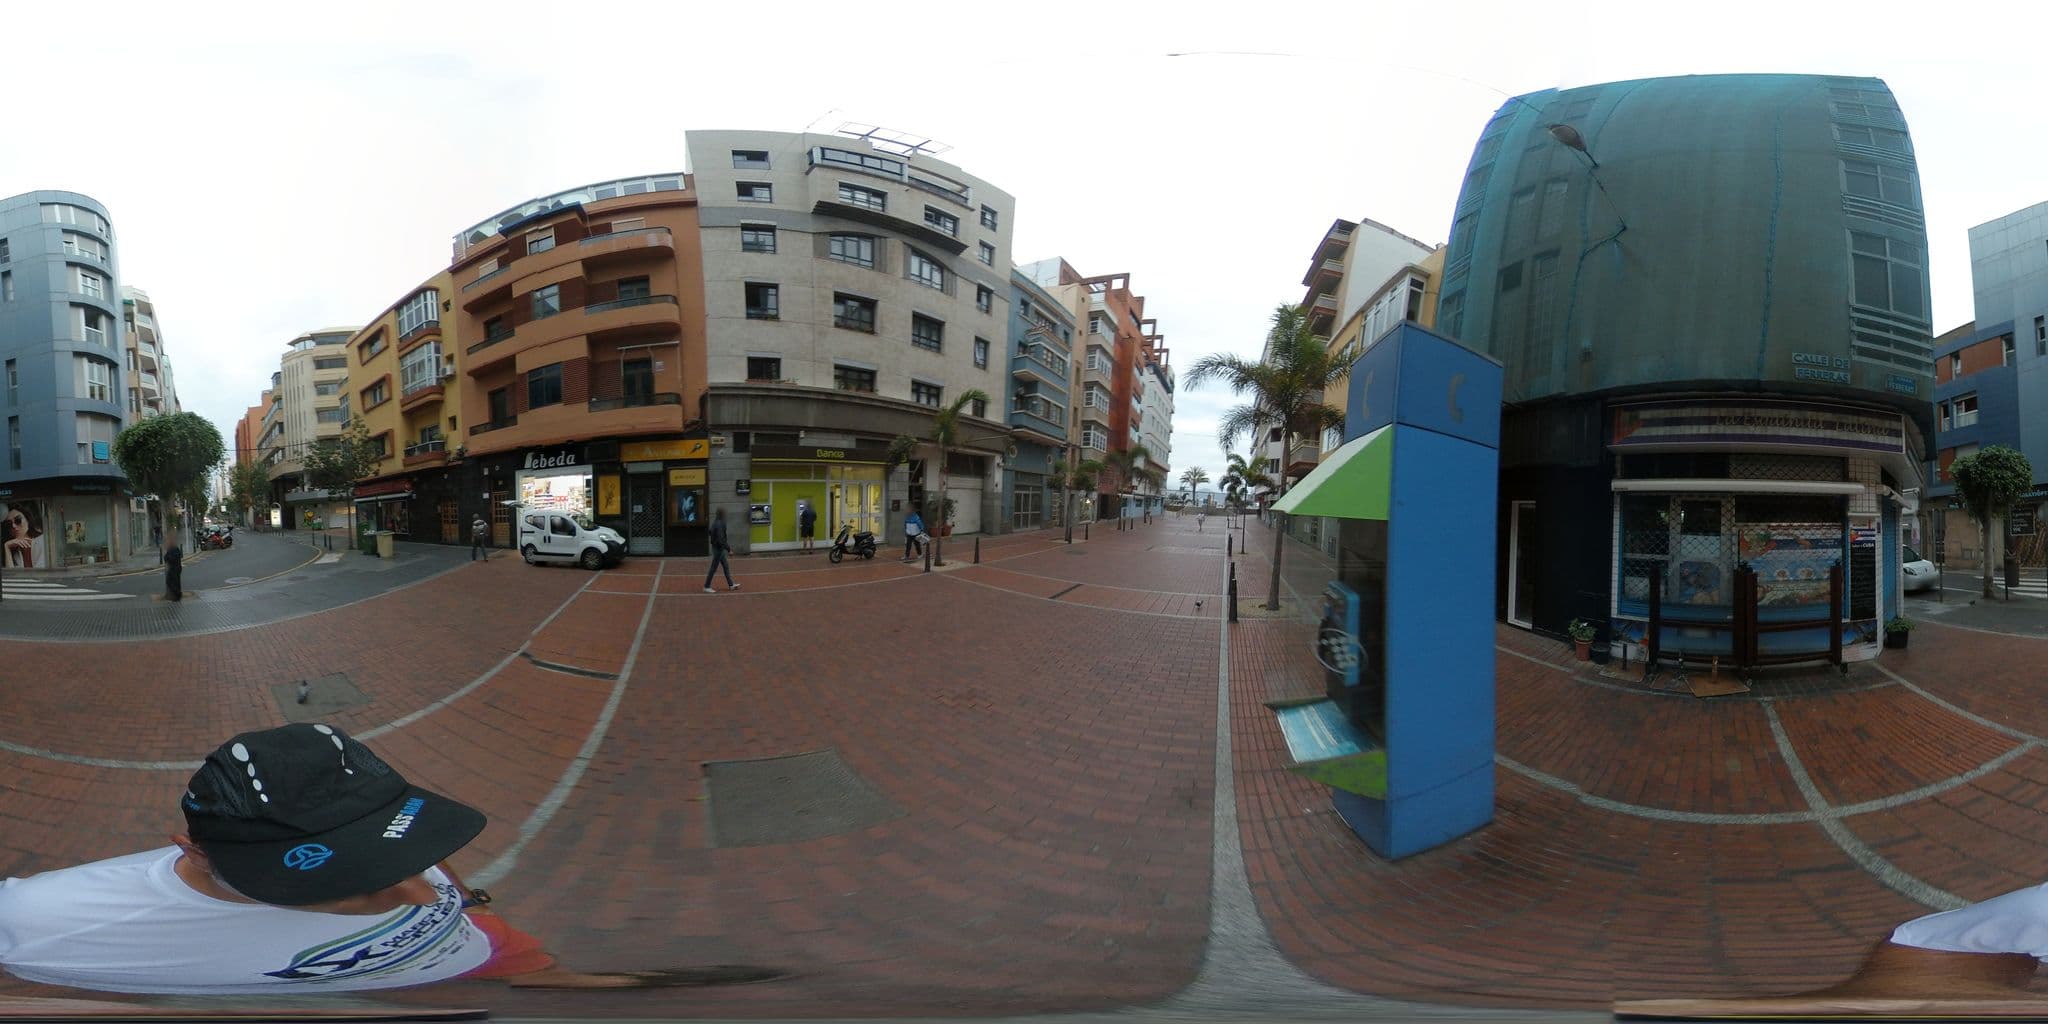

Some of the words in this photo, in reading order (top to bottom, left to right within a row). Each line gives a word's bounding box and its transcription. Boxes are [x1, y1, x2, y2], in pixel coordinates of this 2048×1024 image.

[1793, 353, 1827, 365] CALLE
[1835, 358, 1849, 368] DE
[1797, 368, 1849, 382] FERRERAS
[816, 449, 845, 458] Bankia
